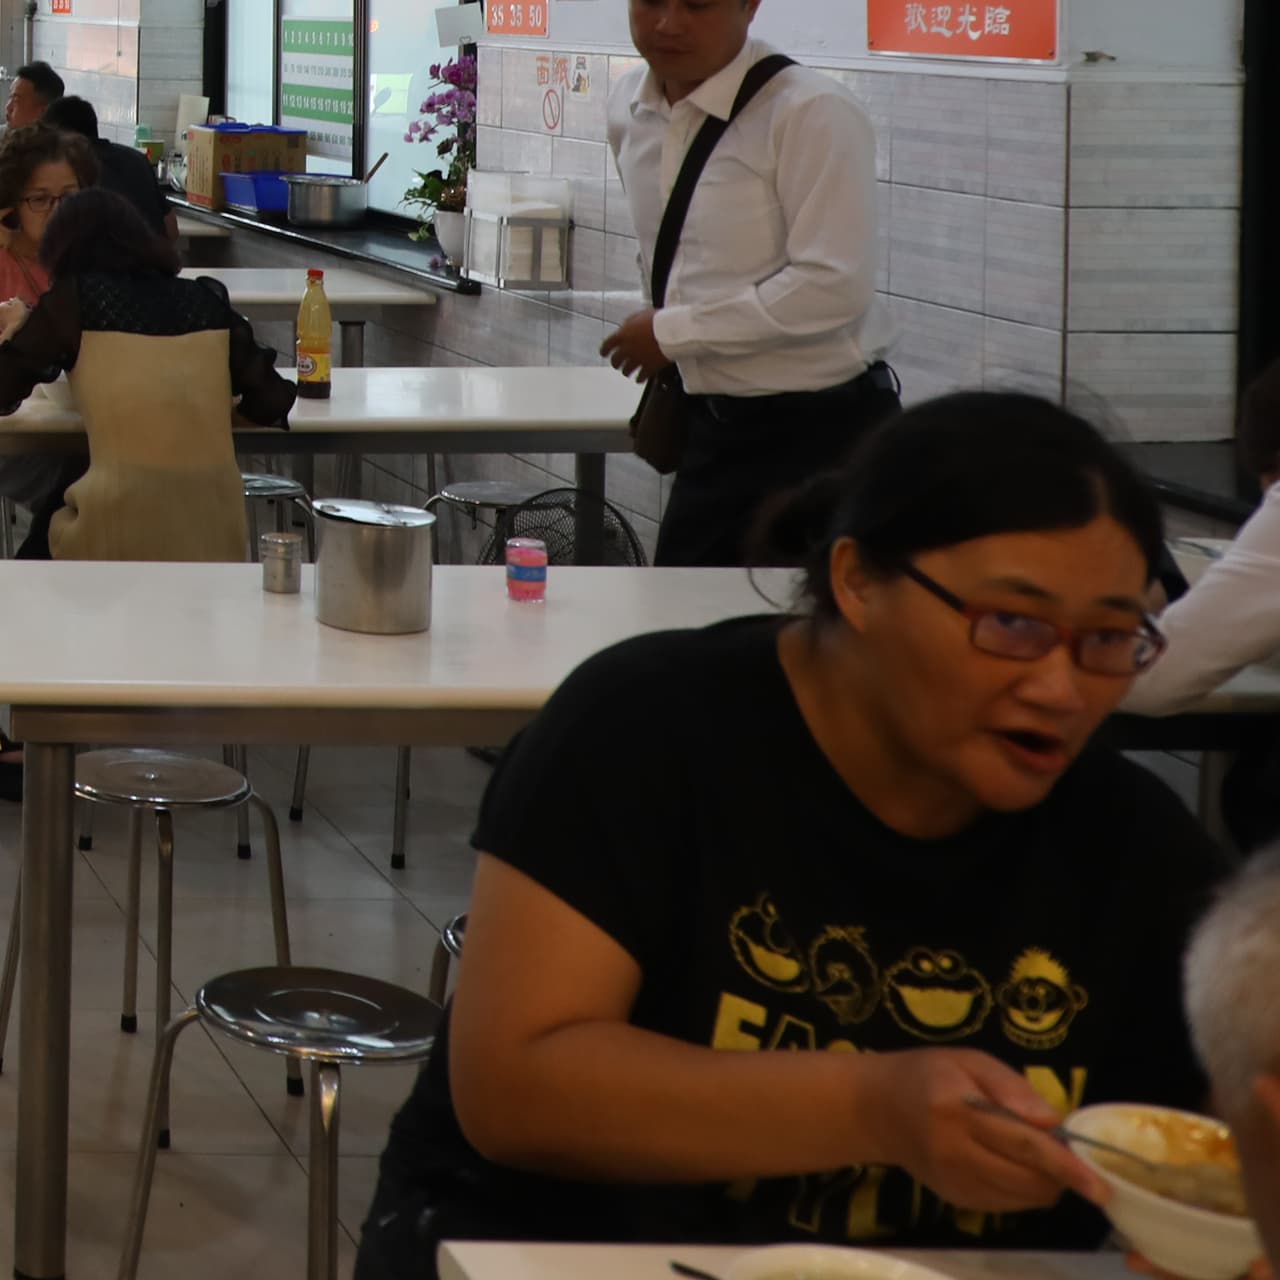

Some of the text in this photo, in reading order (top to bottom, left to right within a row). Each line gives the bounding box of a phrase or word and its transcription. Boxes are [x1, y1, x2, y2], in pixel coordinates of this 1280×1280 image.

[491, 4, 505, 27] 35
[510, 4, 523, 27] 35
[529, 4, 543, 27] 50
[904, 3, 1011, 41] 歡迎光臨
